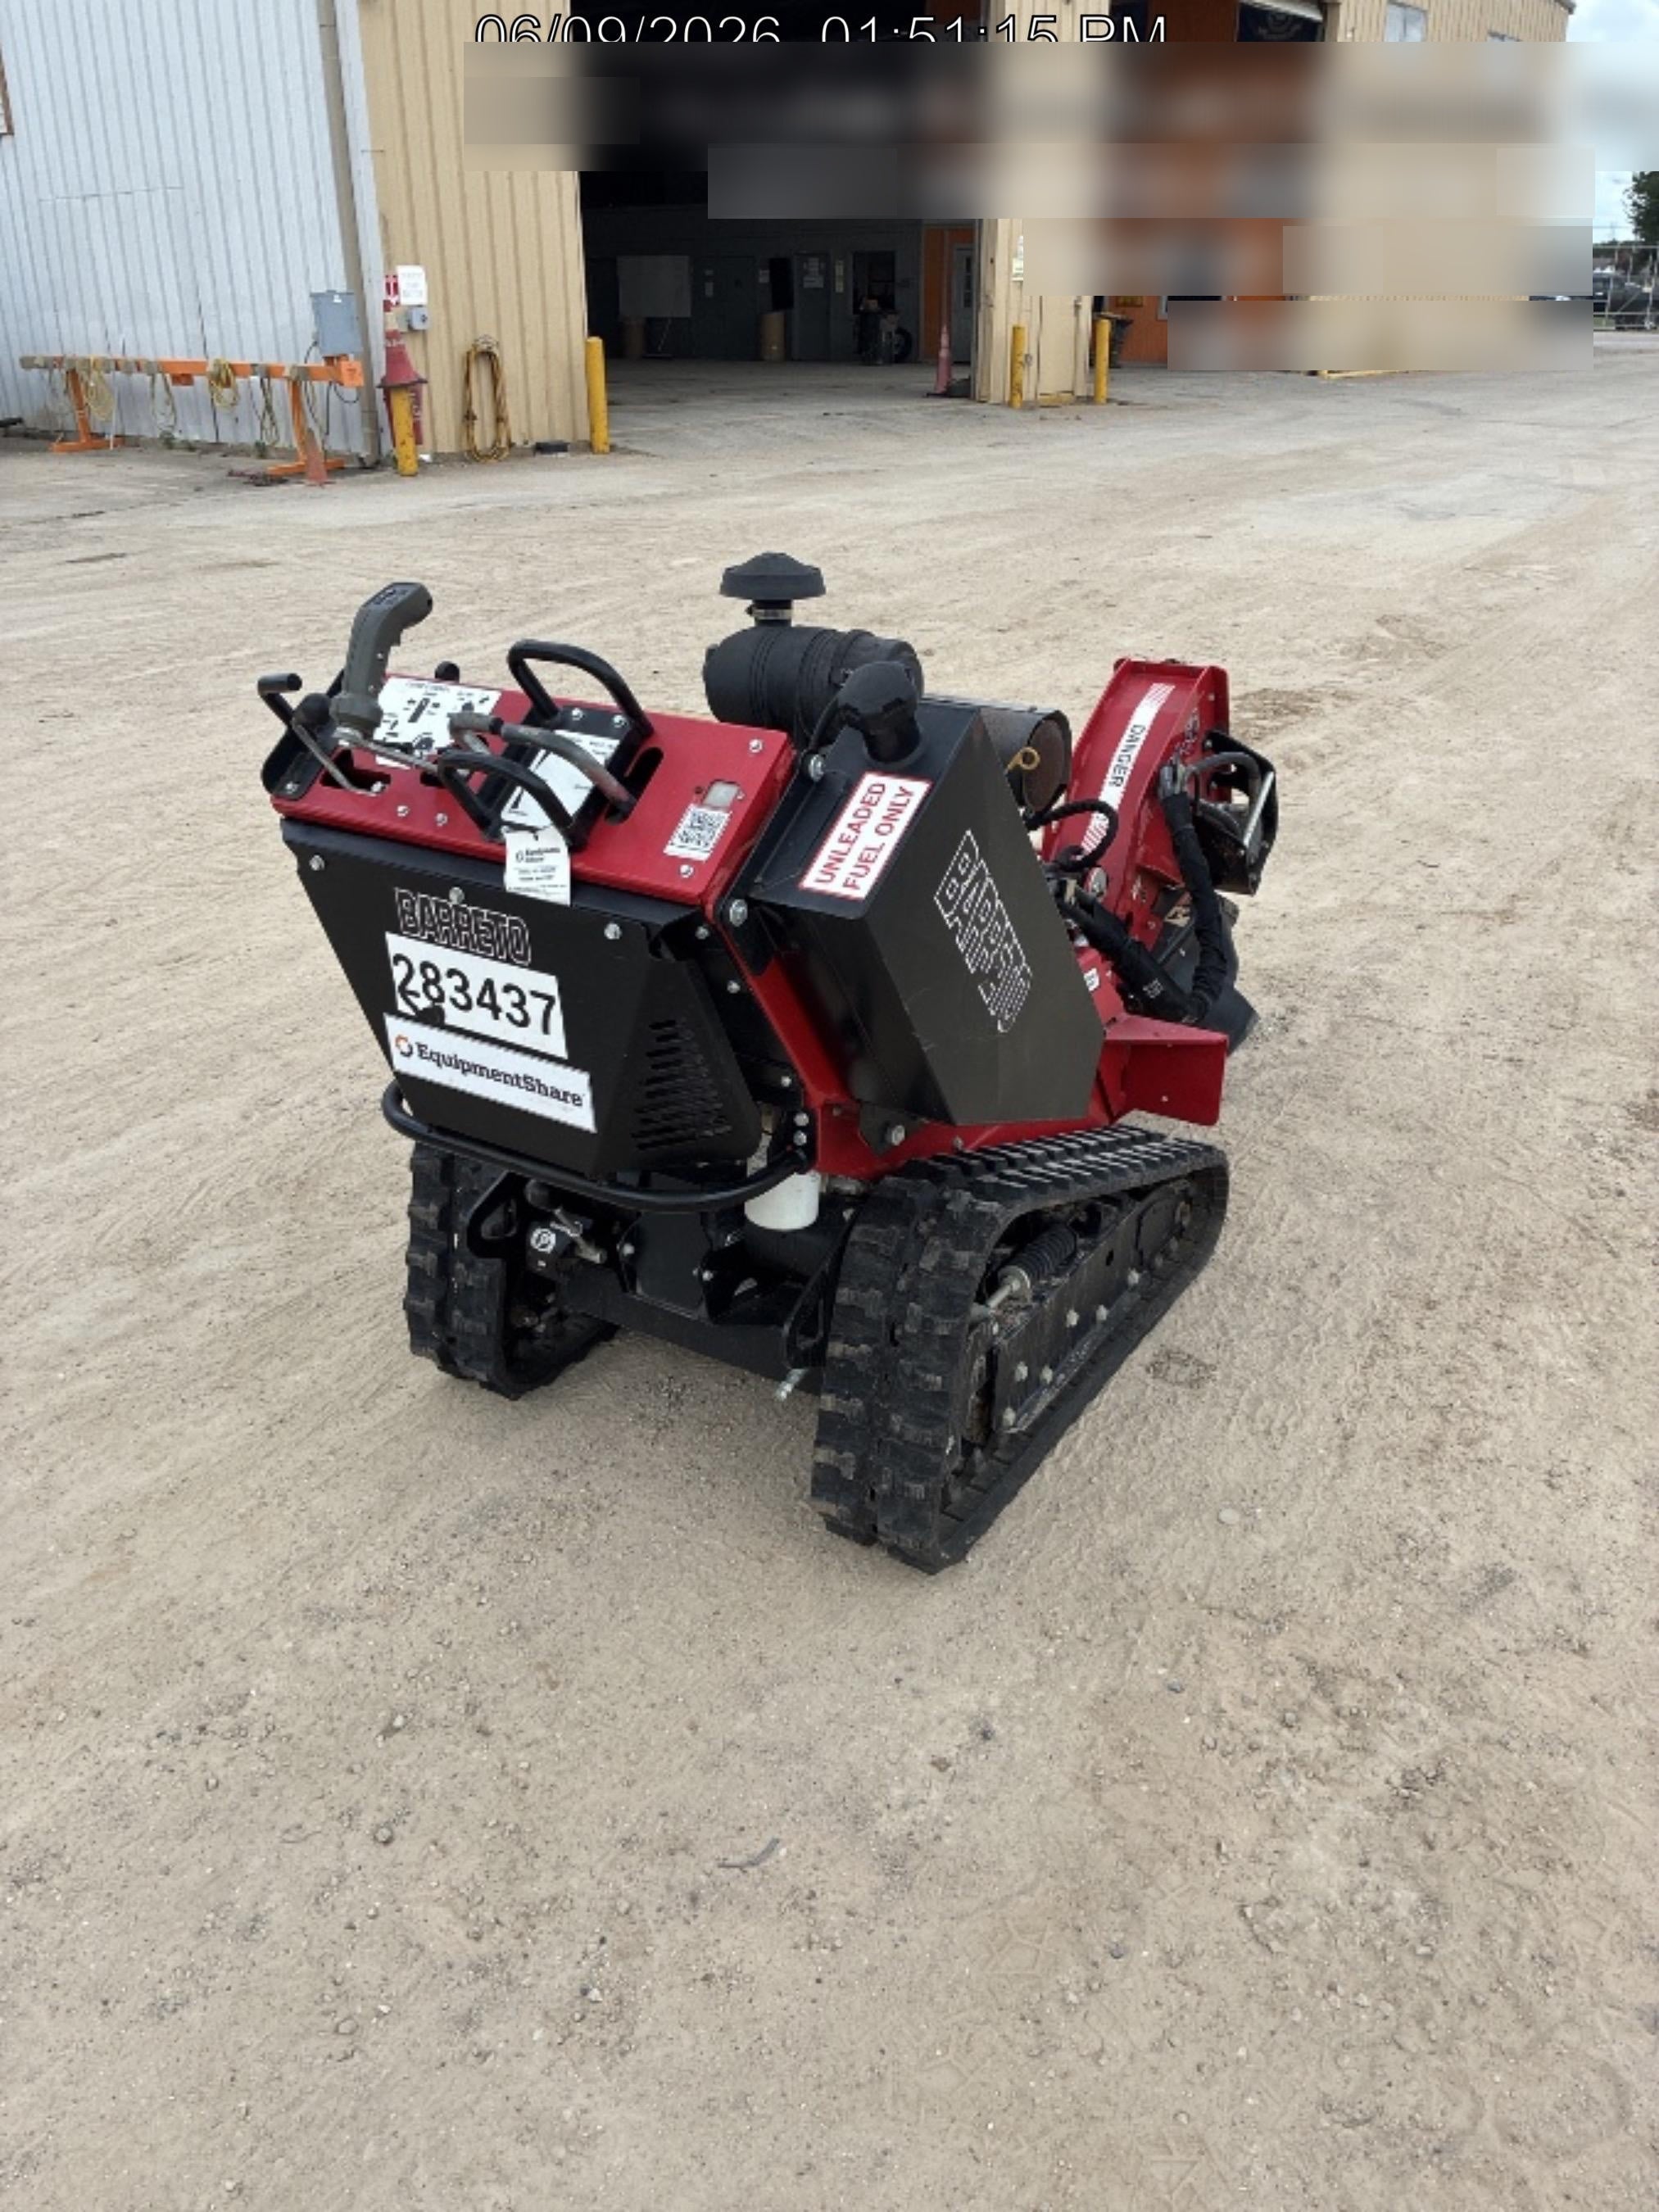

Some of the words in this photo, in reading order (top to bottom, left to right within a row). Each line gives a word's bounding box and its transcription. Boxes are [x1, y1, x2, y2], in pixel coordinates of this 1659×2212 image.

[1108, 723, 1146, 787] DANGER
[815, 783, 886, 883] UNLEADED
[842, 842, 886, 890] FUEL
[875, 786, 914, 836] ONLY
[395, 887, 532, 967] BARRETO
[392, 954, 556, 1036] 283437
[415, 1040, 584, 1107] EquipmentShare
